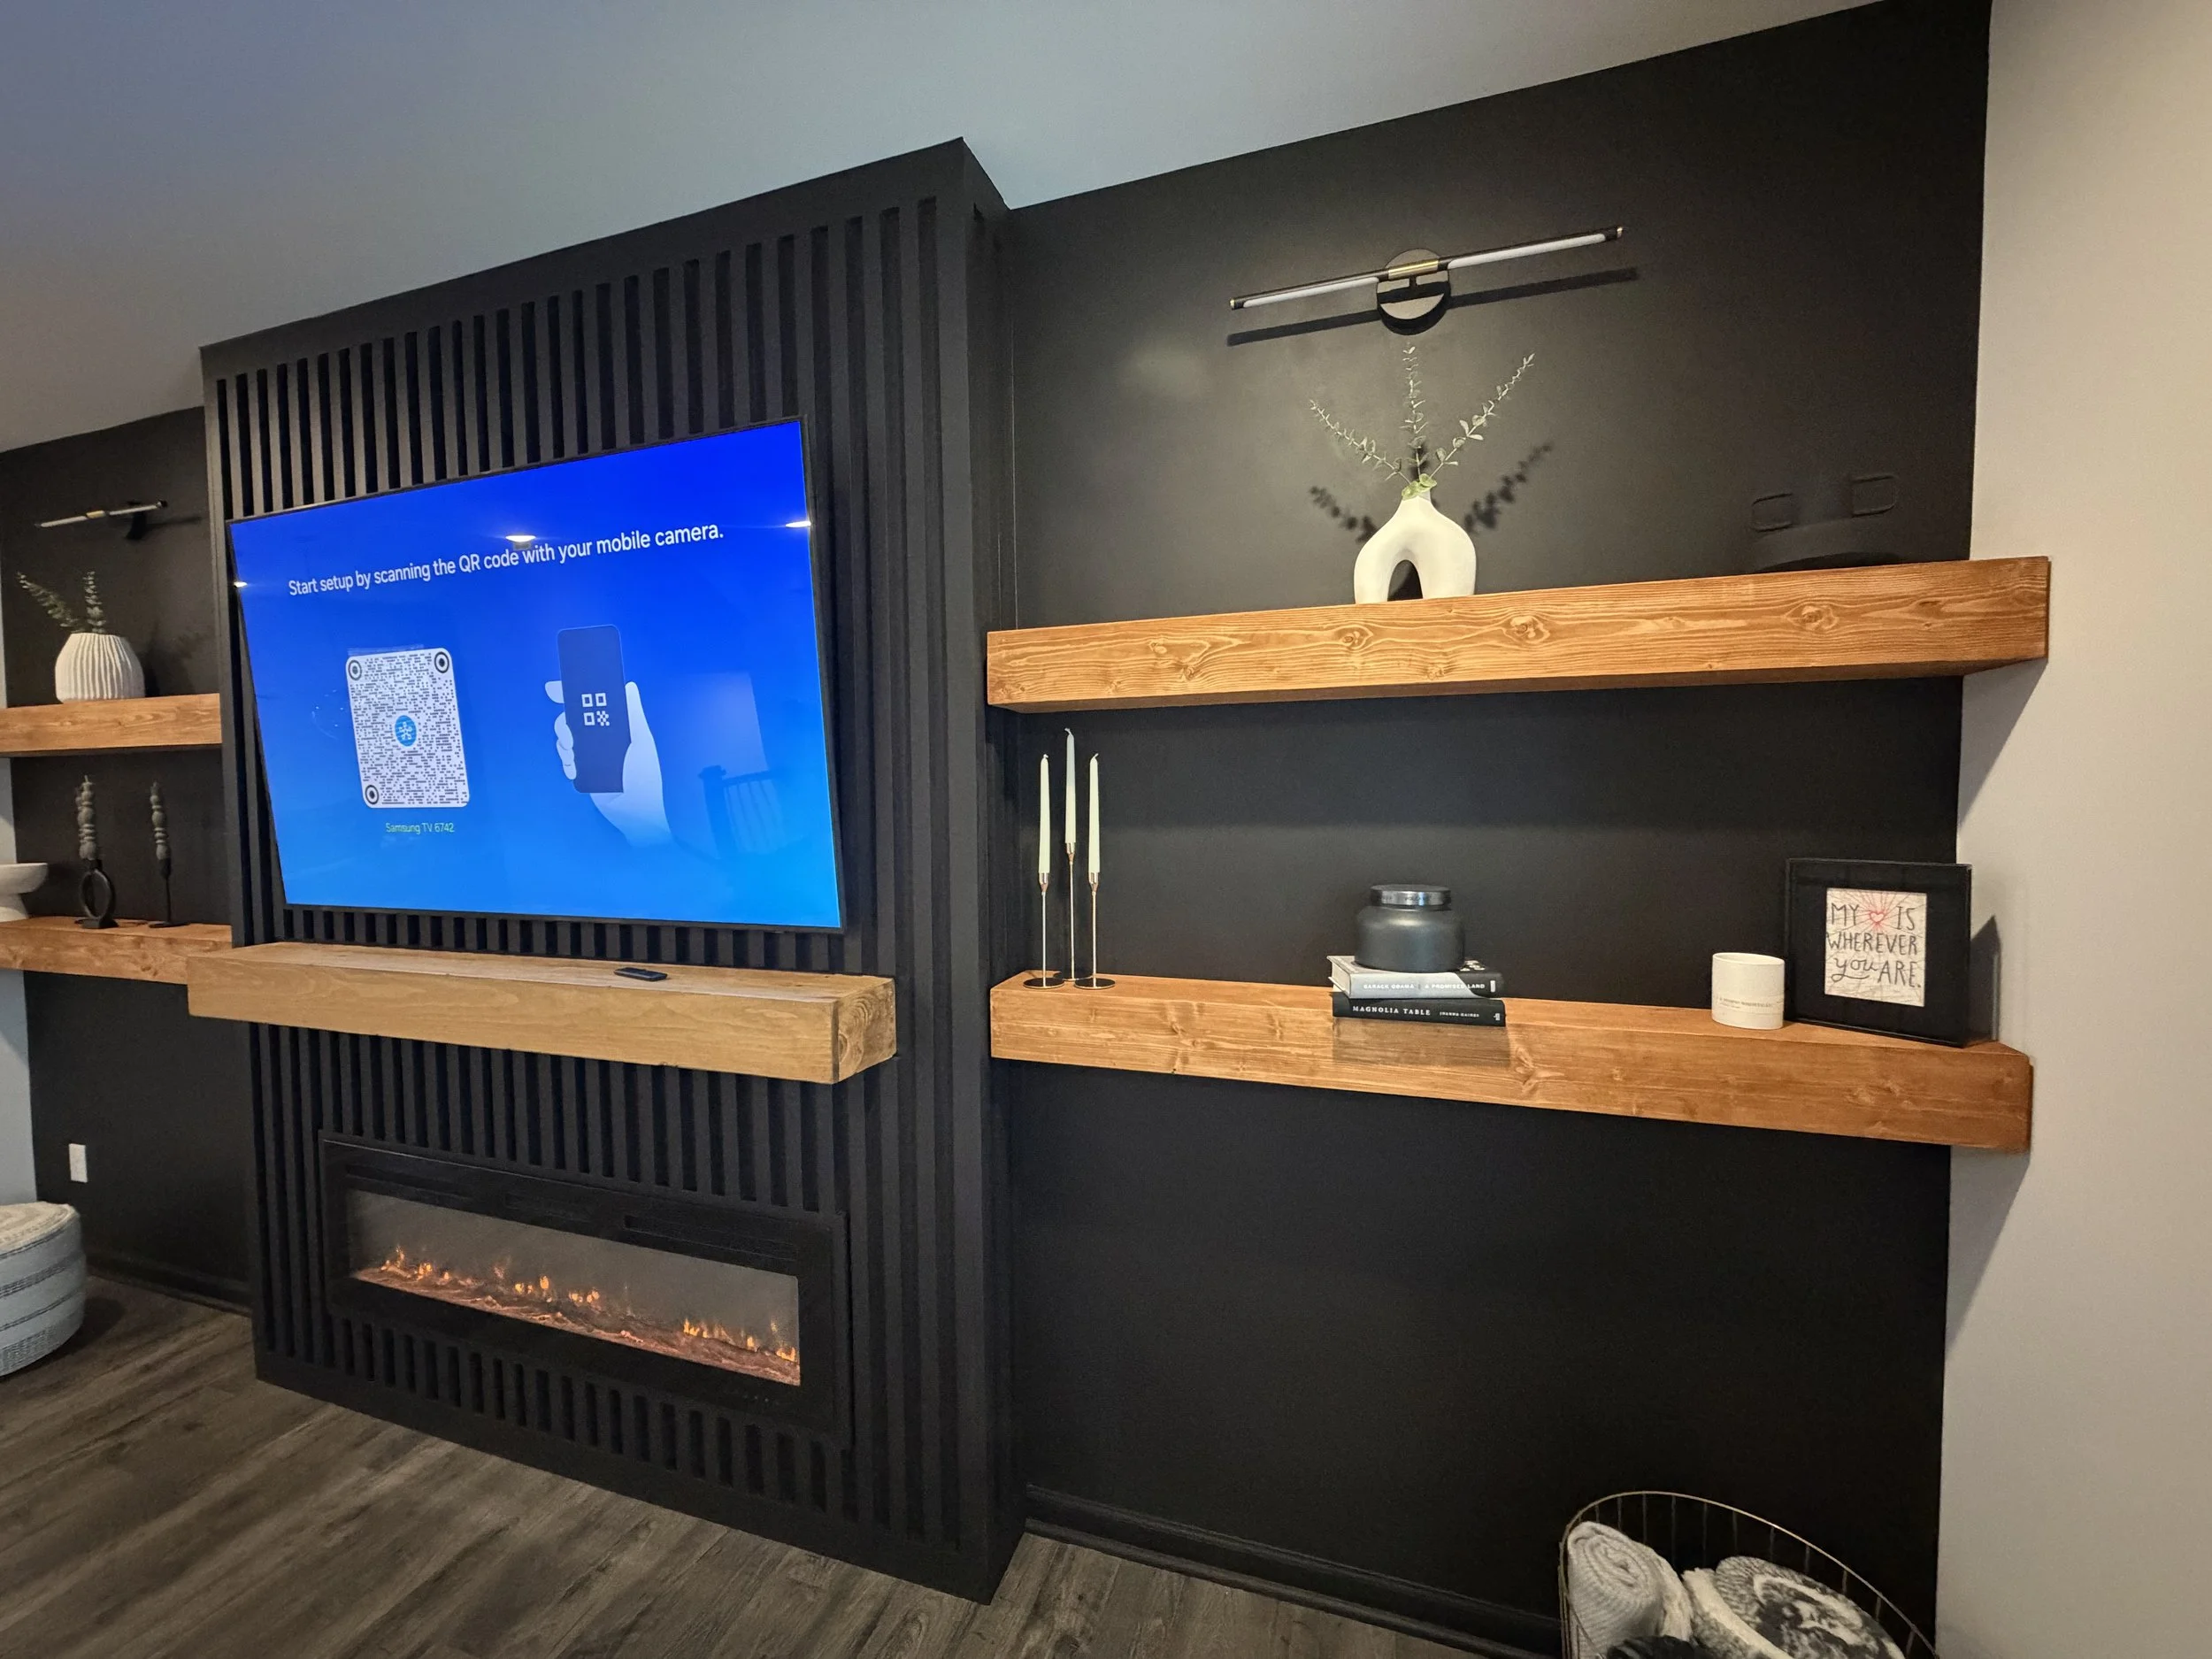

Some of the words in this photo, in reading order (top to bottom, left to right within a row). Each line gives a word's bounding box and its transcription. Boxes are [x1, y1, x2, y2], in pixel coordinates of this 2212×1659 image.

[288, 578, 319, 595] Start
[320, 574, 354, 592] setup
[355, 570, 371, 589] by
[374, 563, 431, 581] scanning
[433, 557, 456, 575] the
[459, 554, 481, 573] QR
[483, 549, 518, 569] code
[521, 542, 555, 564] with
[558, 541, 593, 564] your
[596, 530, 650, 555] mobile
[655, 524, 724, 546] camera.
[385, 822, 421, 835] Samsung
[421, 822, 433, 833] TV
[434, 822, 455, 833] 6742
[1832, 902, 1860, 926] MY
[1896, 905, 1916, 931] IS
[1825, 931, 1917, 956] WHEREVER
[1831, 957, 1878, 983] you
[1878, 960, 1921, 988] ARE.
[1352, 1005, 1399, 1014] MAGNOLIA
